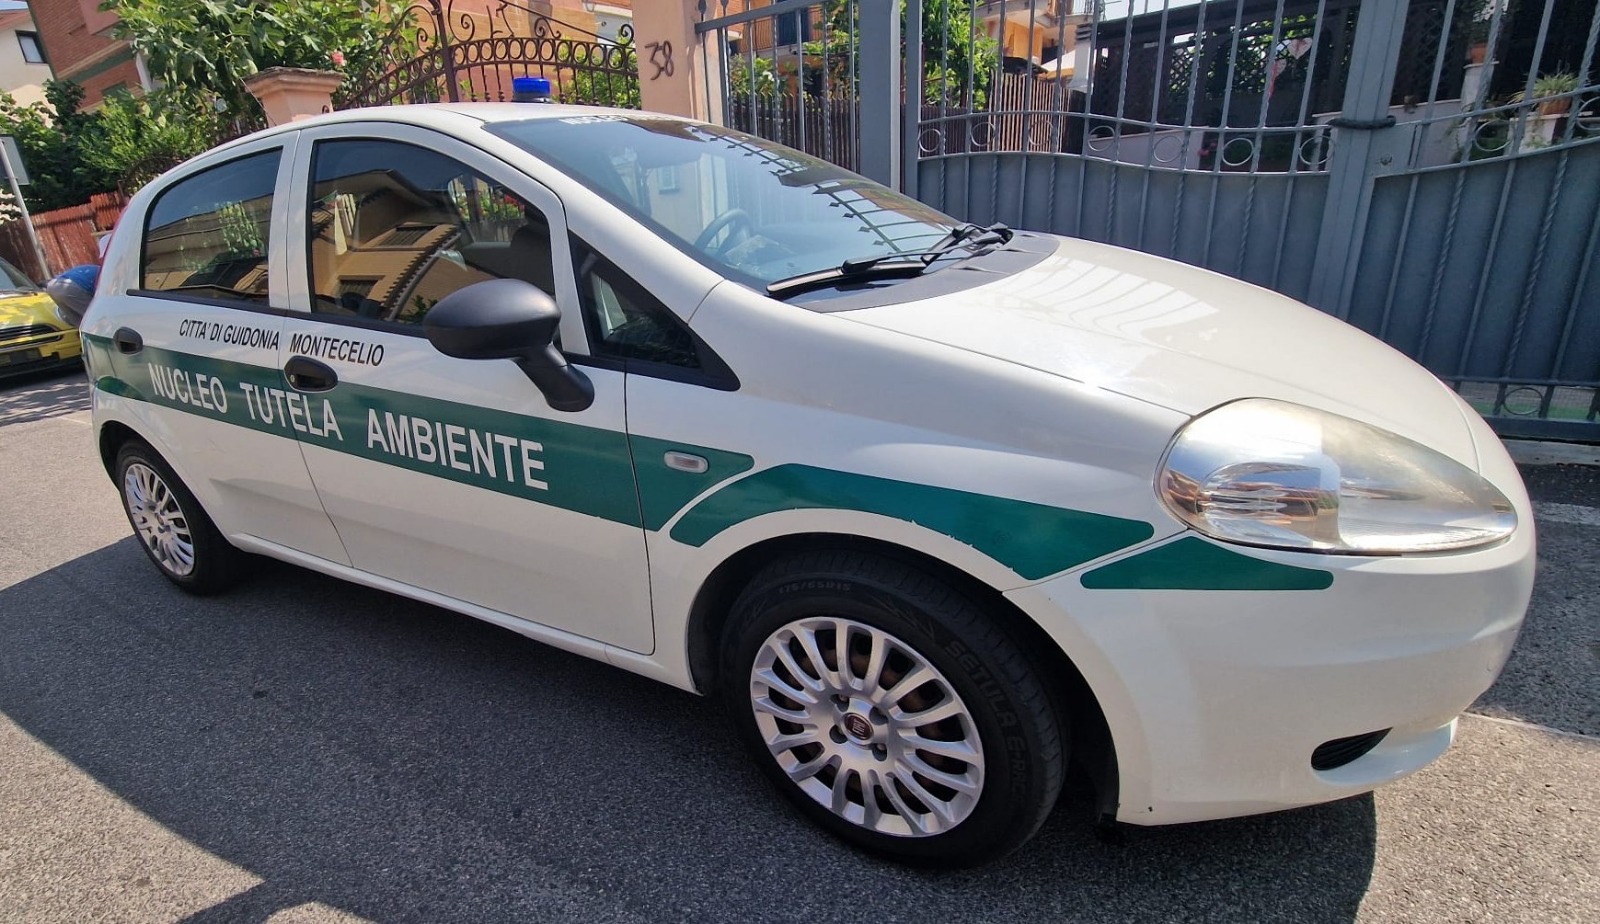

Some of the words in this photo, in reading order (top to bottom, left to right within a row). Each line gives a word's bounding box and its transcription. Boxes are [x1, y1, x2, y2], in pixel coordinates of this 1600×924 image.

[645, 40, 674, 81] 38
[179, 318, 211, 339] CITTA'
[209, 323, 221, 343] DI
[223, 325, 280, 350] GUIDONIA
[289, 333, 385, 366] MONTECELIO
[148, 362, 228, 414] NUCLEO
[239, 382, 344, 441] TUTELA
[367, 408, 549, 490] AMBIENTE
